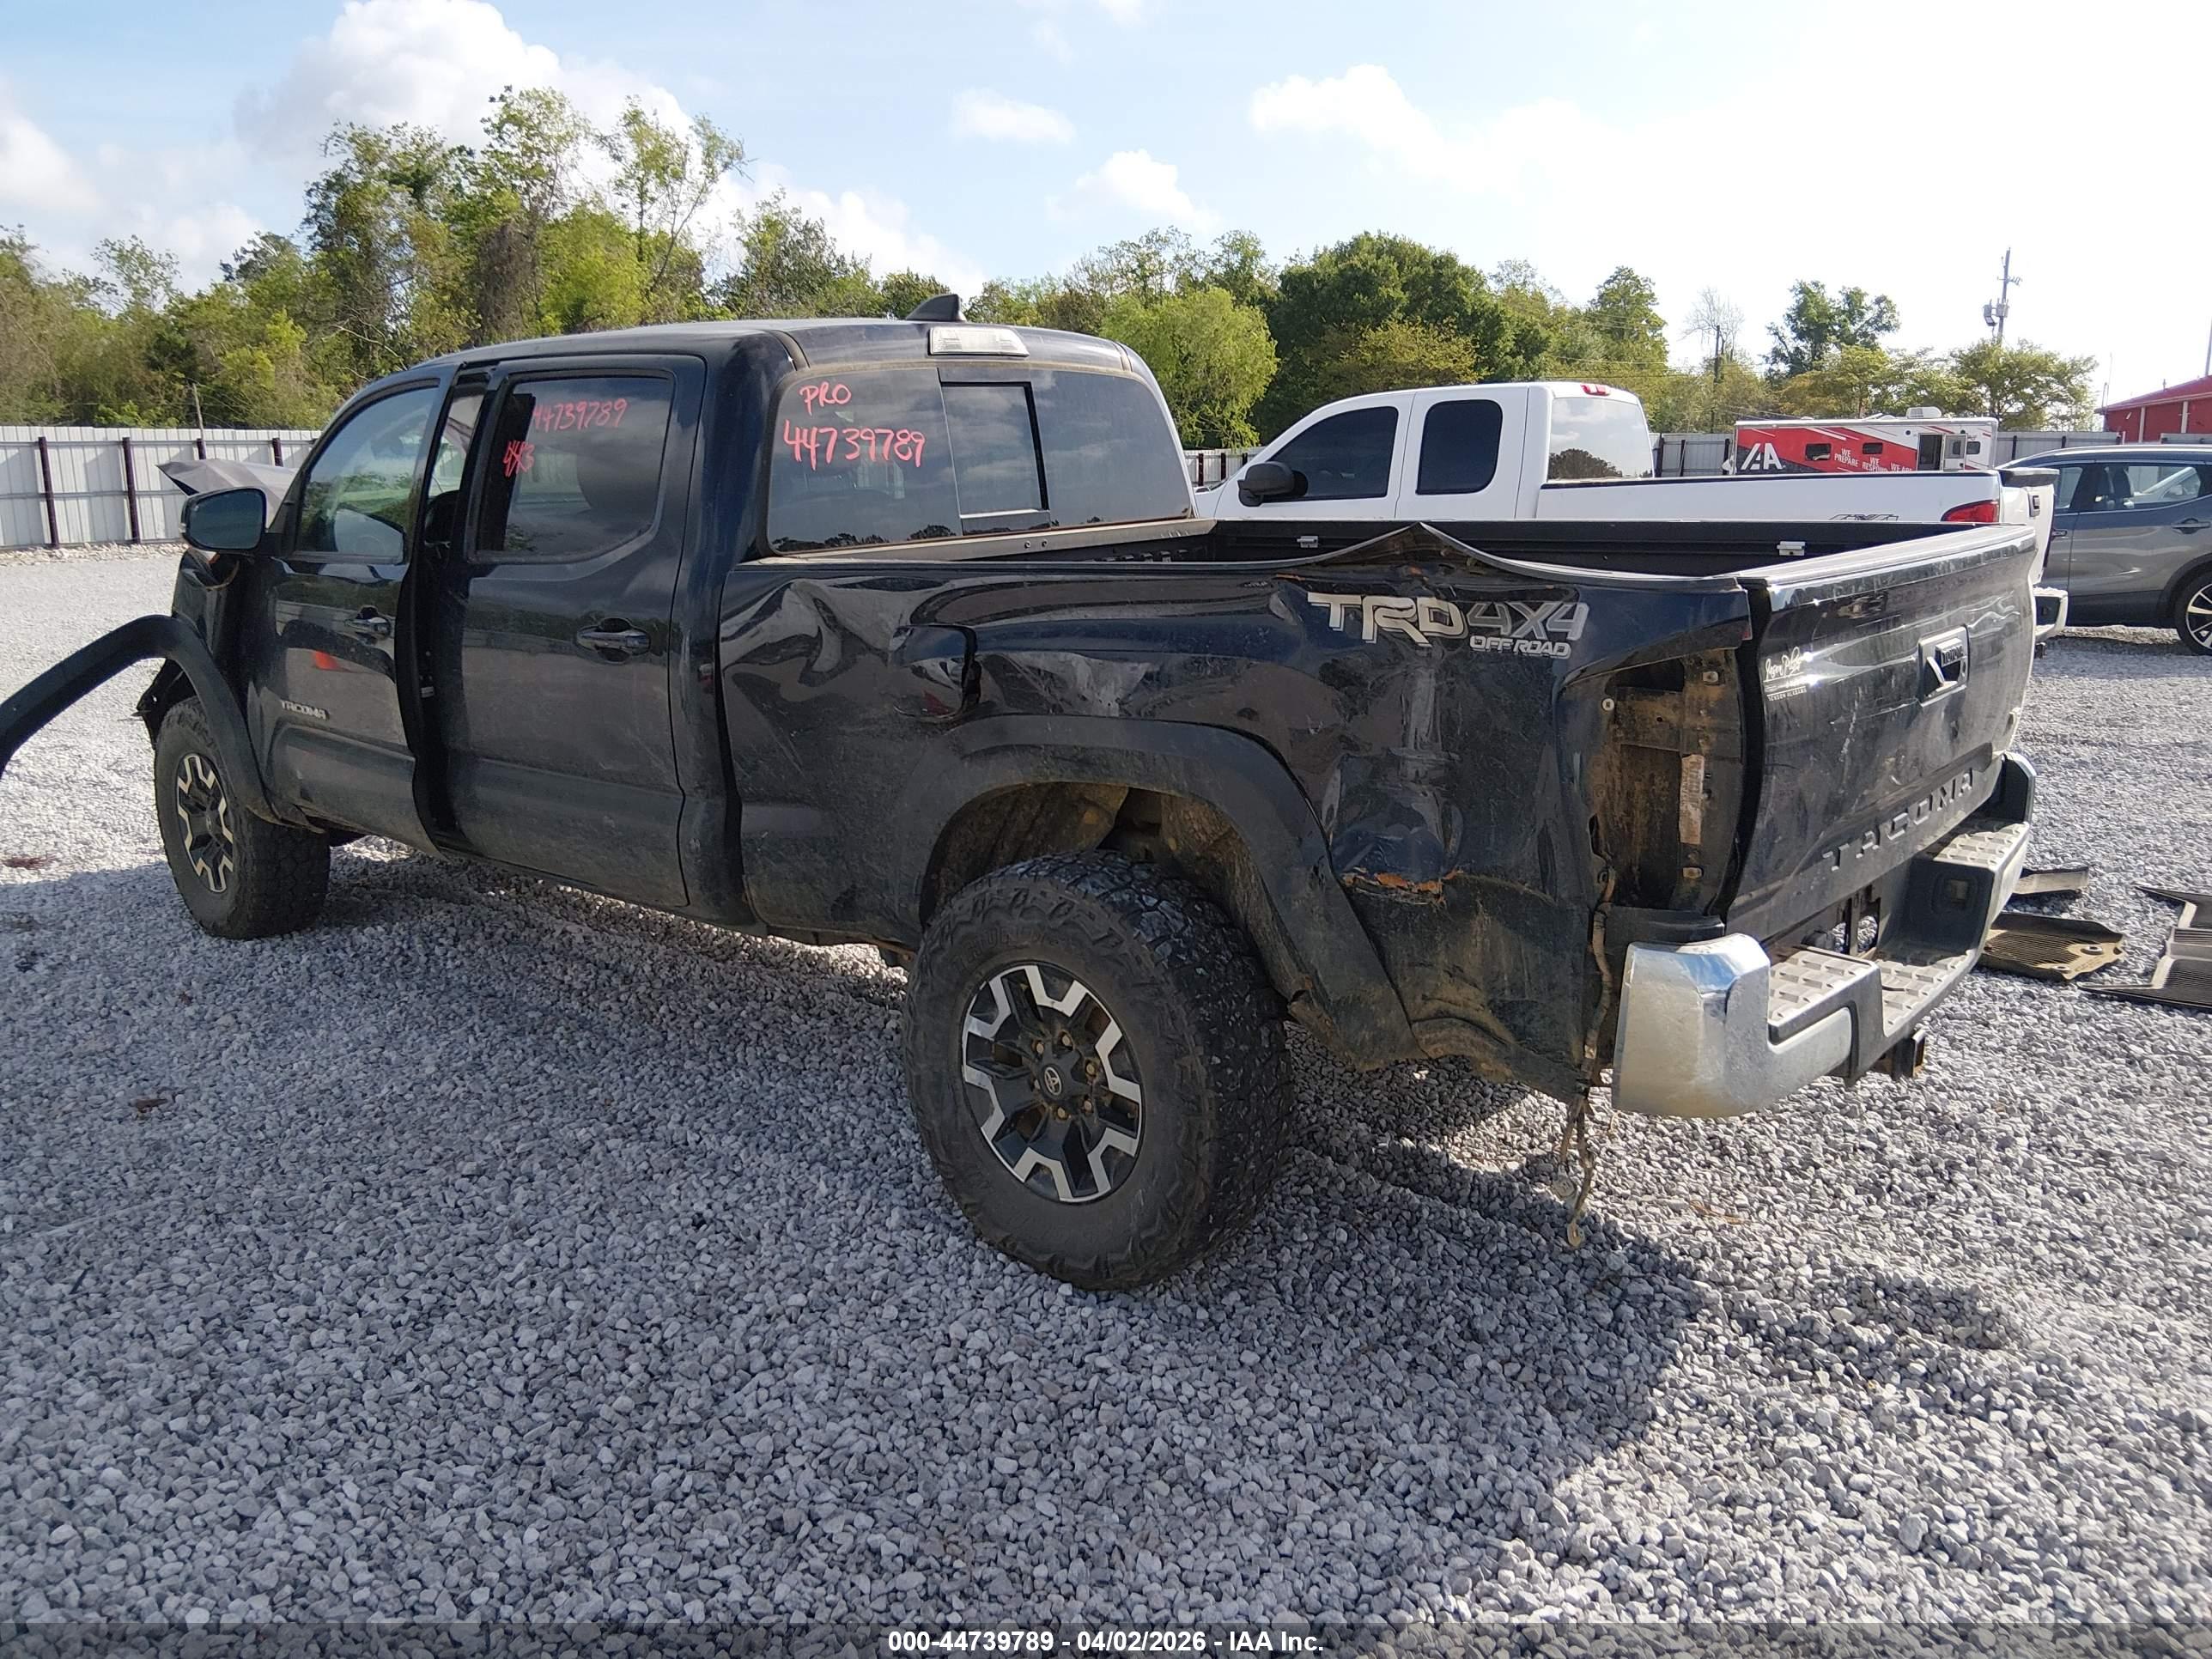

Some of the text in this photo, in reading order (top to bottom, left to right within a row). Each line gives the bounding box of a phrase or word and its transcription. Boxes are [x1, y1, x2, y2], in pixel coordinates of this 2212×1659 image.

[799, 380, 852, 416] PRO
[782, 418, 926, 471] 44739789
[1841, 447, 1852, 458] WE
[1834, 453, 1860, 468] PREPARE
[1869, 456, 1881, 466] WE
[1307, 592, 1468, 647] TRD
[1469, 635, 1572, 660] OFF ROAD
[280, 699, 327, 720] TACOMA
[1821, 767, 1973, 872] TACOMA
